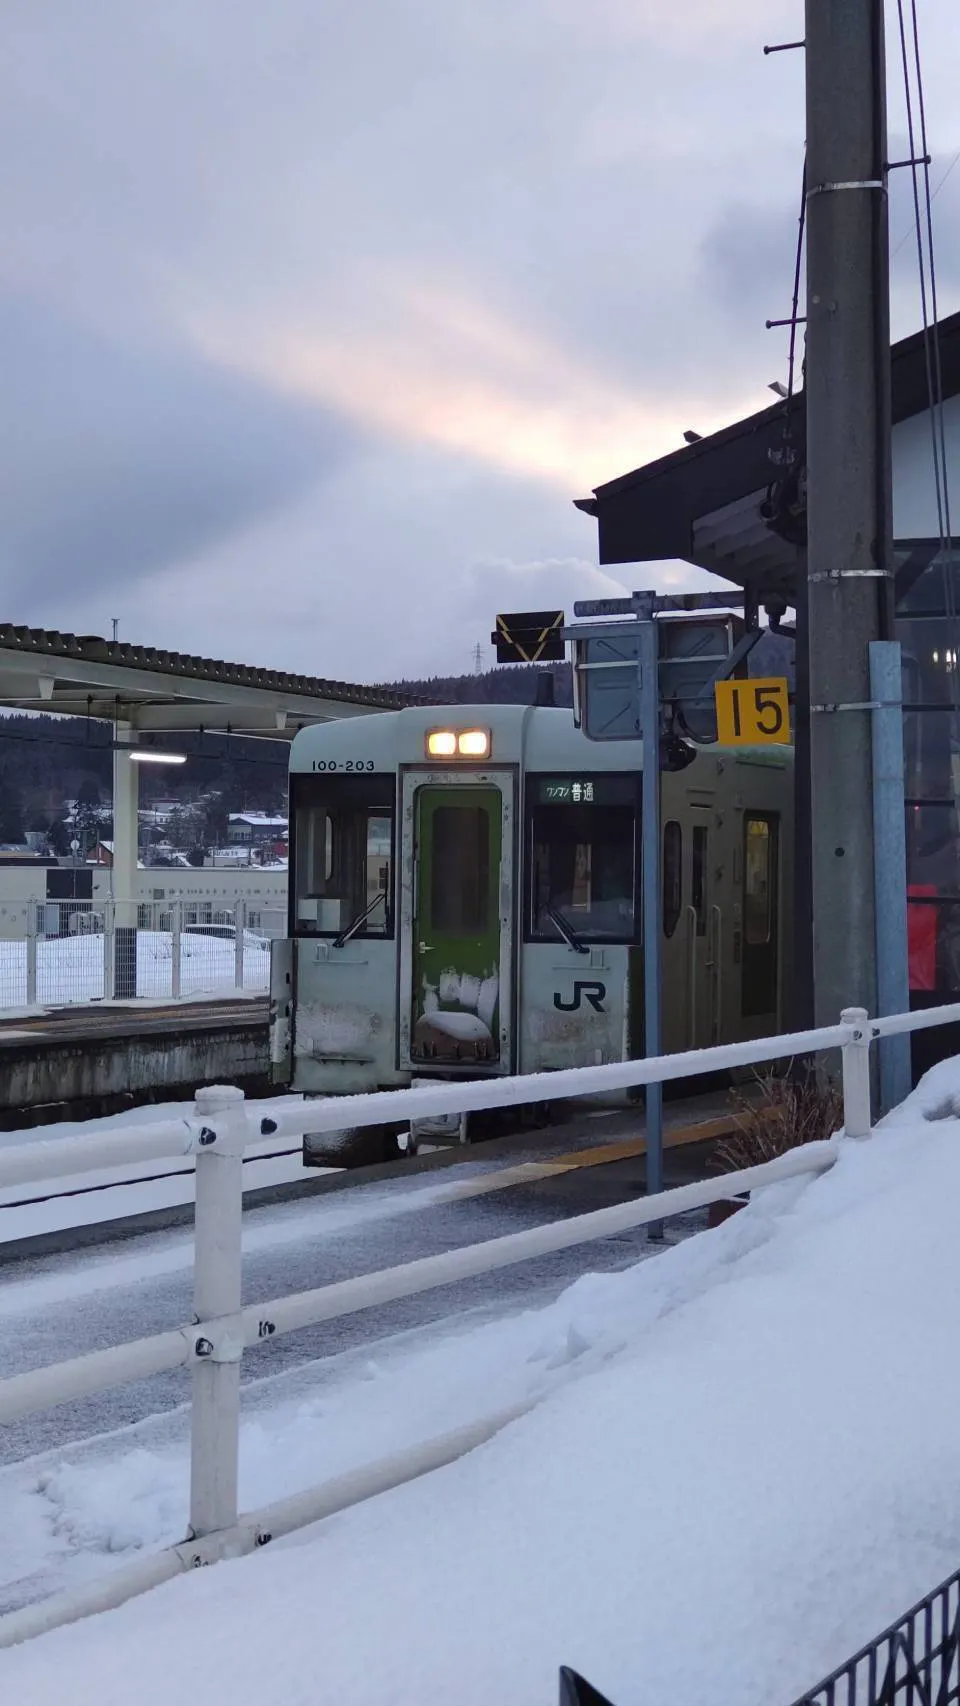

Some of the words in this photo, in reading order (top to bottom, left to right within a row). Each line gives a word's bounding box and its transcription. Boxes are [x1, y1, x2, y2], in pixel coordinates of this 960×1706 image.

[732, 686, 783, 736] 15
[312, 760, 375, 772] 100-203
[553, 981, 607, 1012] JR
